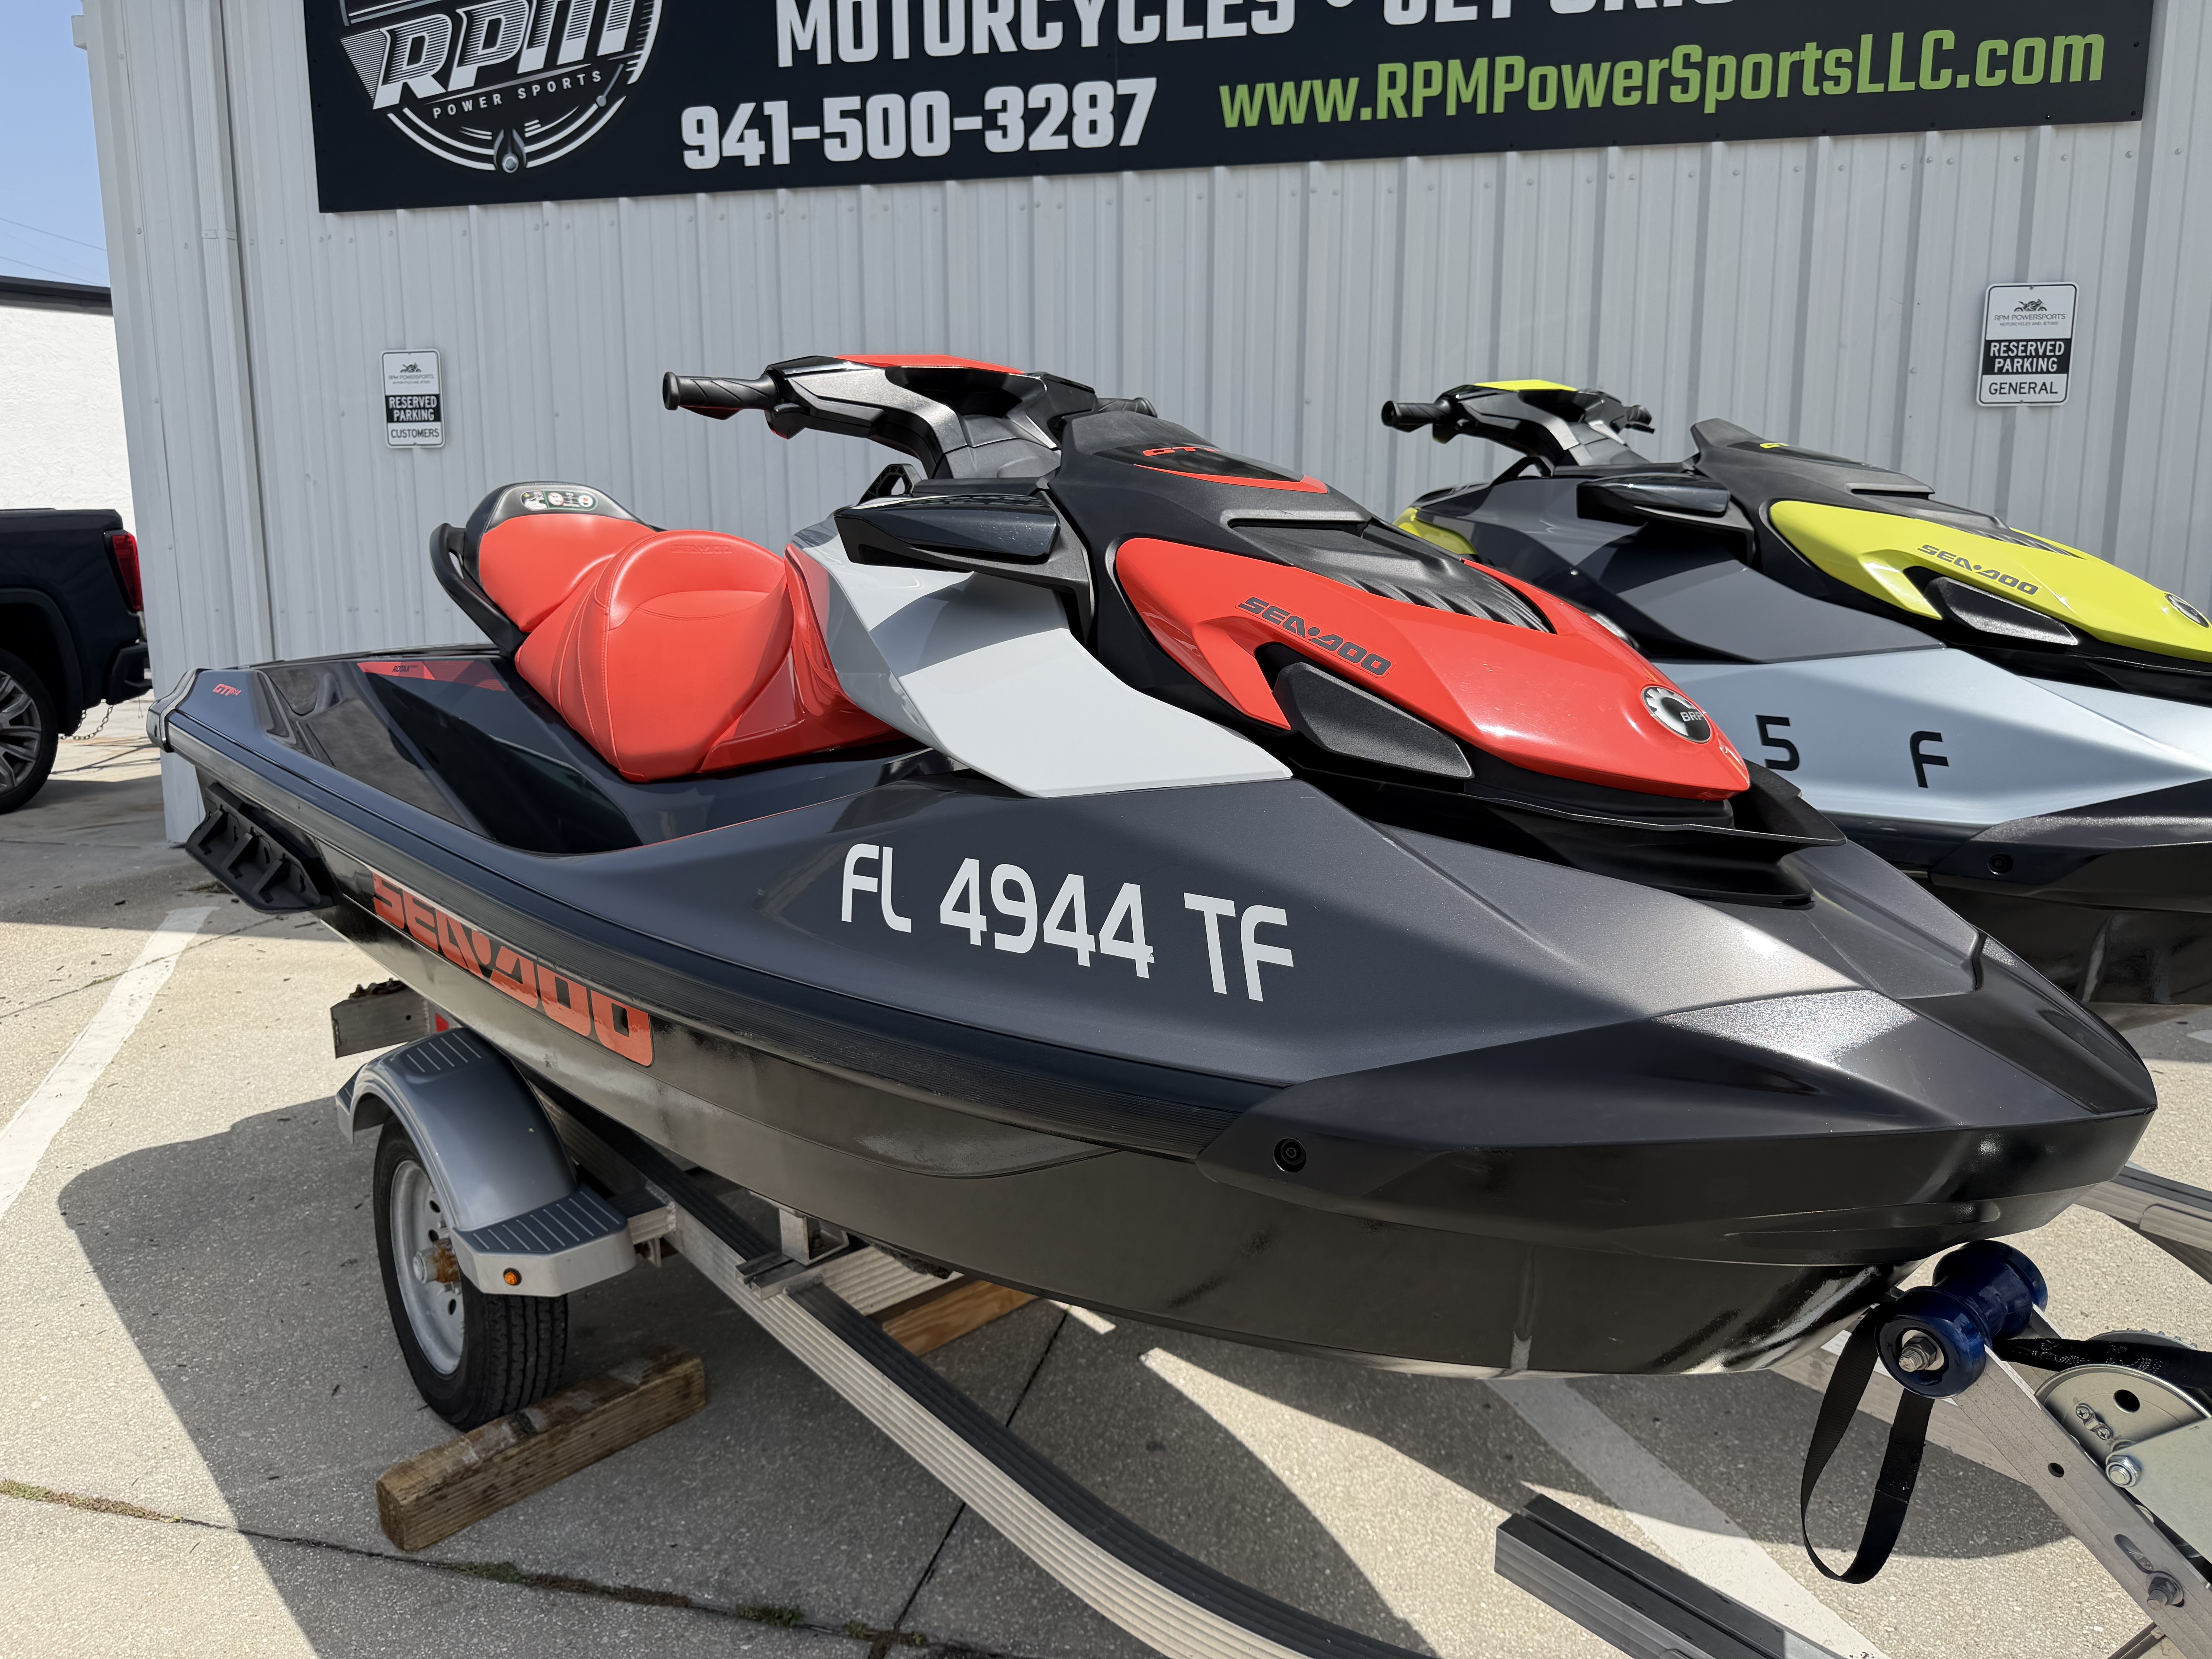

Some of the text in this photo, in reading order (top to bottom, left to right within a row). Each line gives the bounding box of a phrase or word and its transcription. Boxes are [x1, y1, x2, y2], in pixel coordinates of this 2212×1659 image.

[1219, 30, 2104, 127] www.RPMPowerSportsLLC.com
[433, 70, 602, 119] POWER SPORTS
[681, 77, 1156, 169] 941-500-3287
[1990, 342, 2064, 356] RESERVED
[1994, 358, 2057, 373] PARKING
[1989, 382, 2058, 395] GENERAL
[389, 396, 437, 409] RESERVED
[393, 409, 434, 421] PARKING
[391, 428, 440, 438] CUSTOMERS
[1680, 711, 1702, 721] BRP
[1910, 730, 1949, 788] F
[842, 843, 1294, 1002] FL 4944 TF
